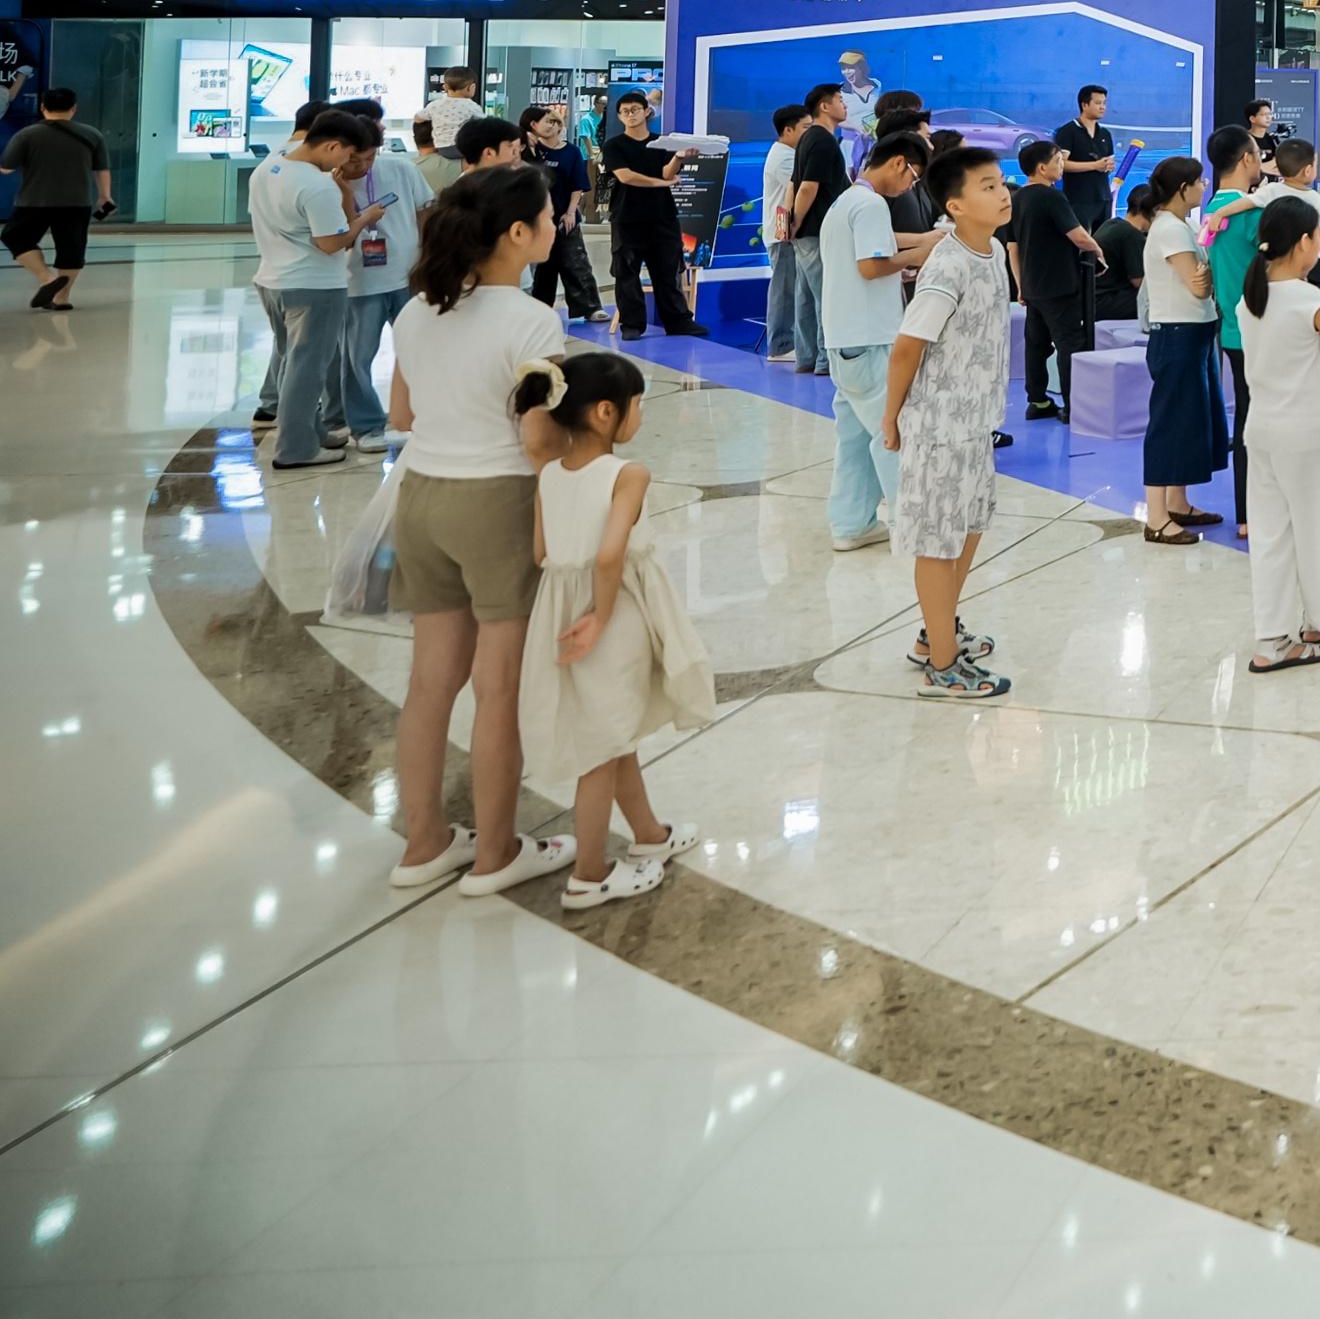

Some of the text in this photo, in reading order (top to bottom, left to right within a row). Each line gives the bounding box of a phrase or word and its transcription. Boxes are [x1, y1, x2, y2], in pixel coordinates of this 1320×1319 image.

[330, 71, 371, 81] 什么专业
[339, 84, 361, 96] Mac
